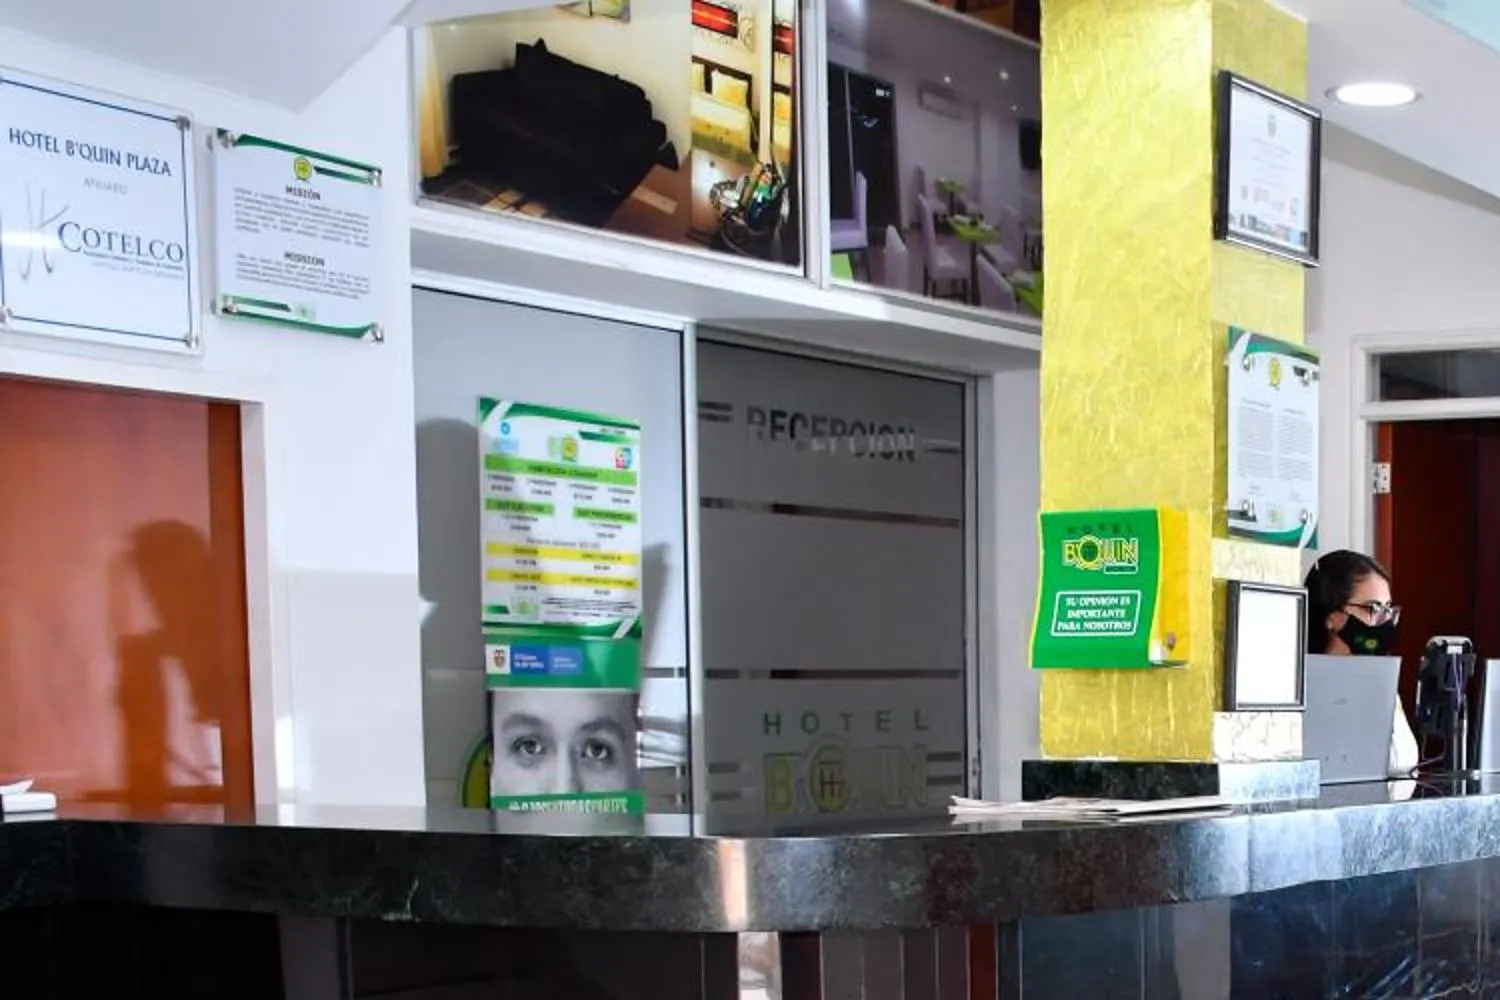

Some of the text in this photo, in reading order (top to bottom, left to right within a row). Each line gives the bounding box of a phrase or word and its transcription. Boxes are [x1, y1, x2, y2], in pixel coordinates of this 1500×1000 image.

[9, 127, 60, 153] HOTEL
[127, 152, 172, 177] PLAZA
[762, 708, 931, 737] HOTEL
